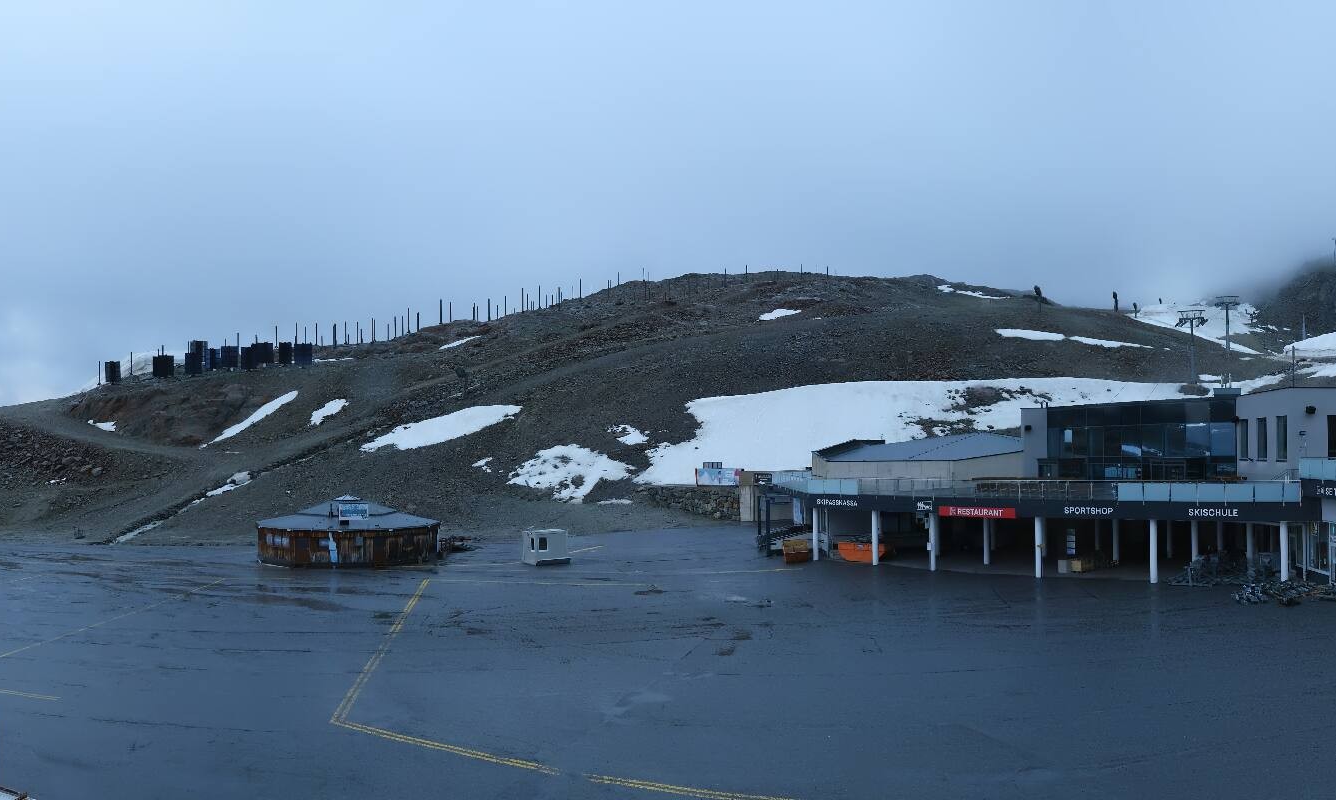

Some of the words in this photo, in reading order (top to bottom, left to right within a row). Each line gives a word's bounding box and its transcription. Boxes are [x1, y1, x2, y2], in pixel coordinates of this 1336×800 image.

[957, 507, 1004, 517] RESTAURANT
[1064, 506, 1114, 515] SPORTSHOP
[1188, 508, 1239, 517] SKISCHULE
